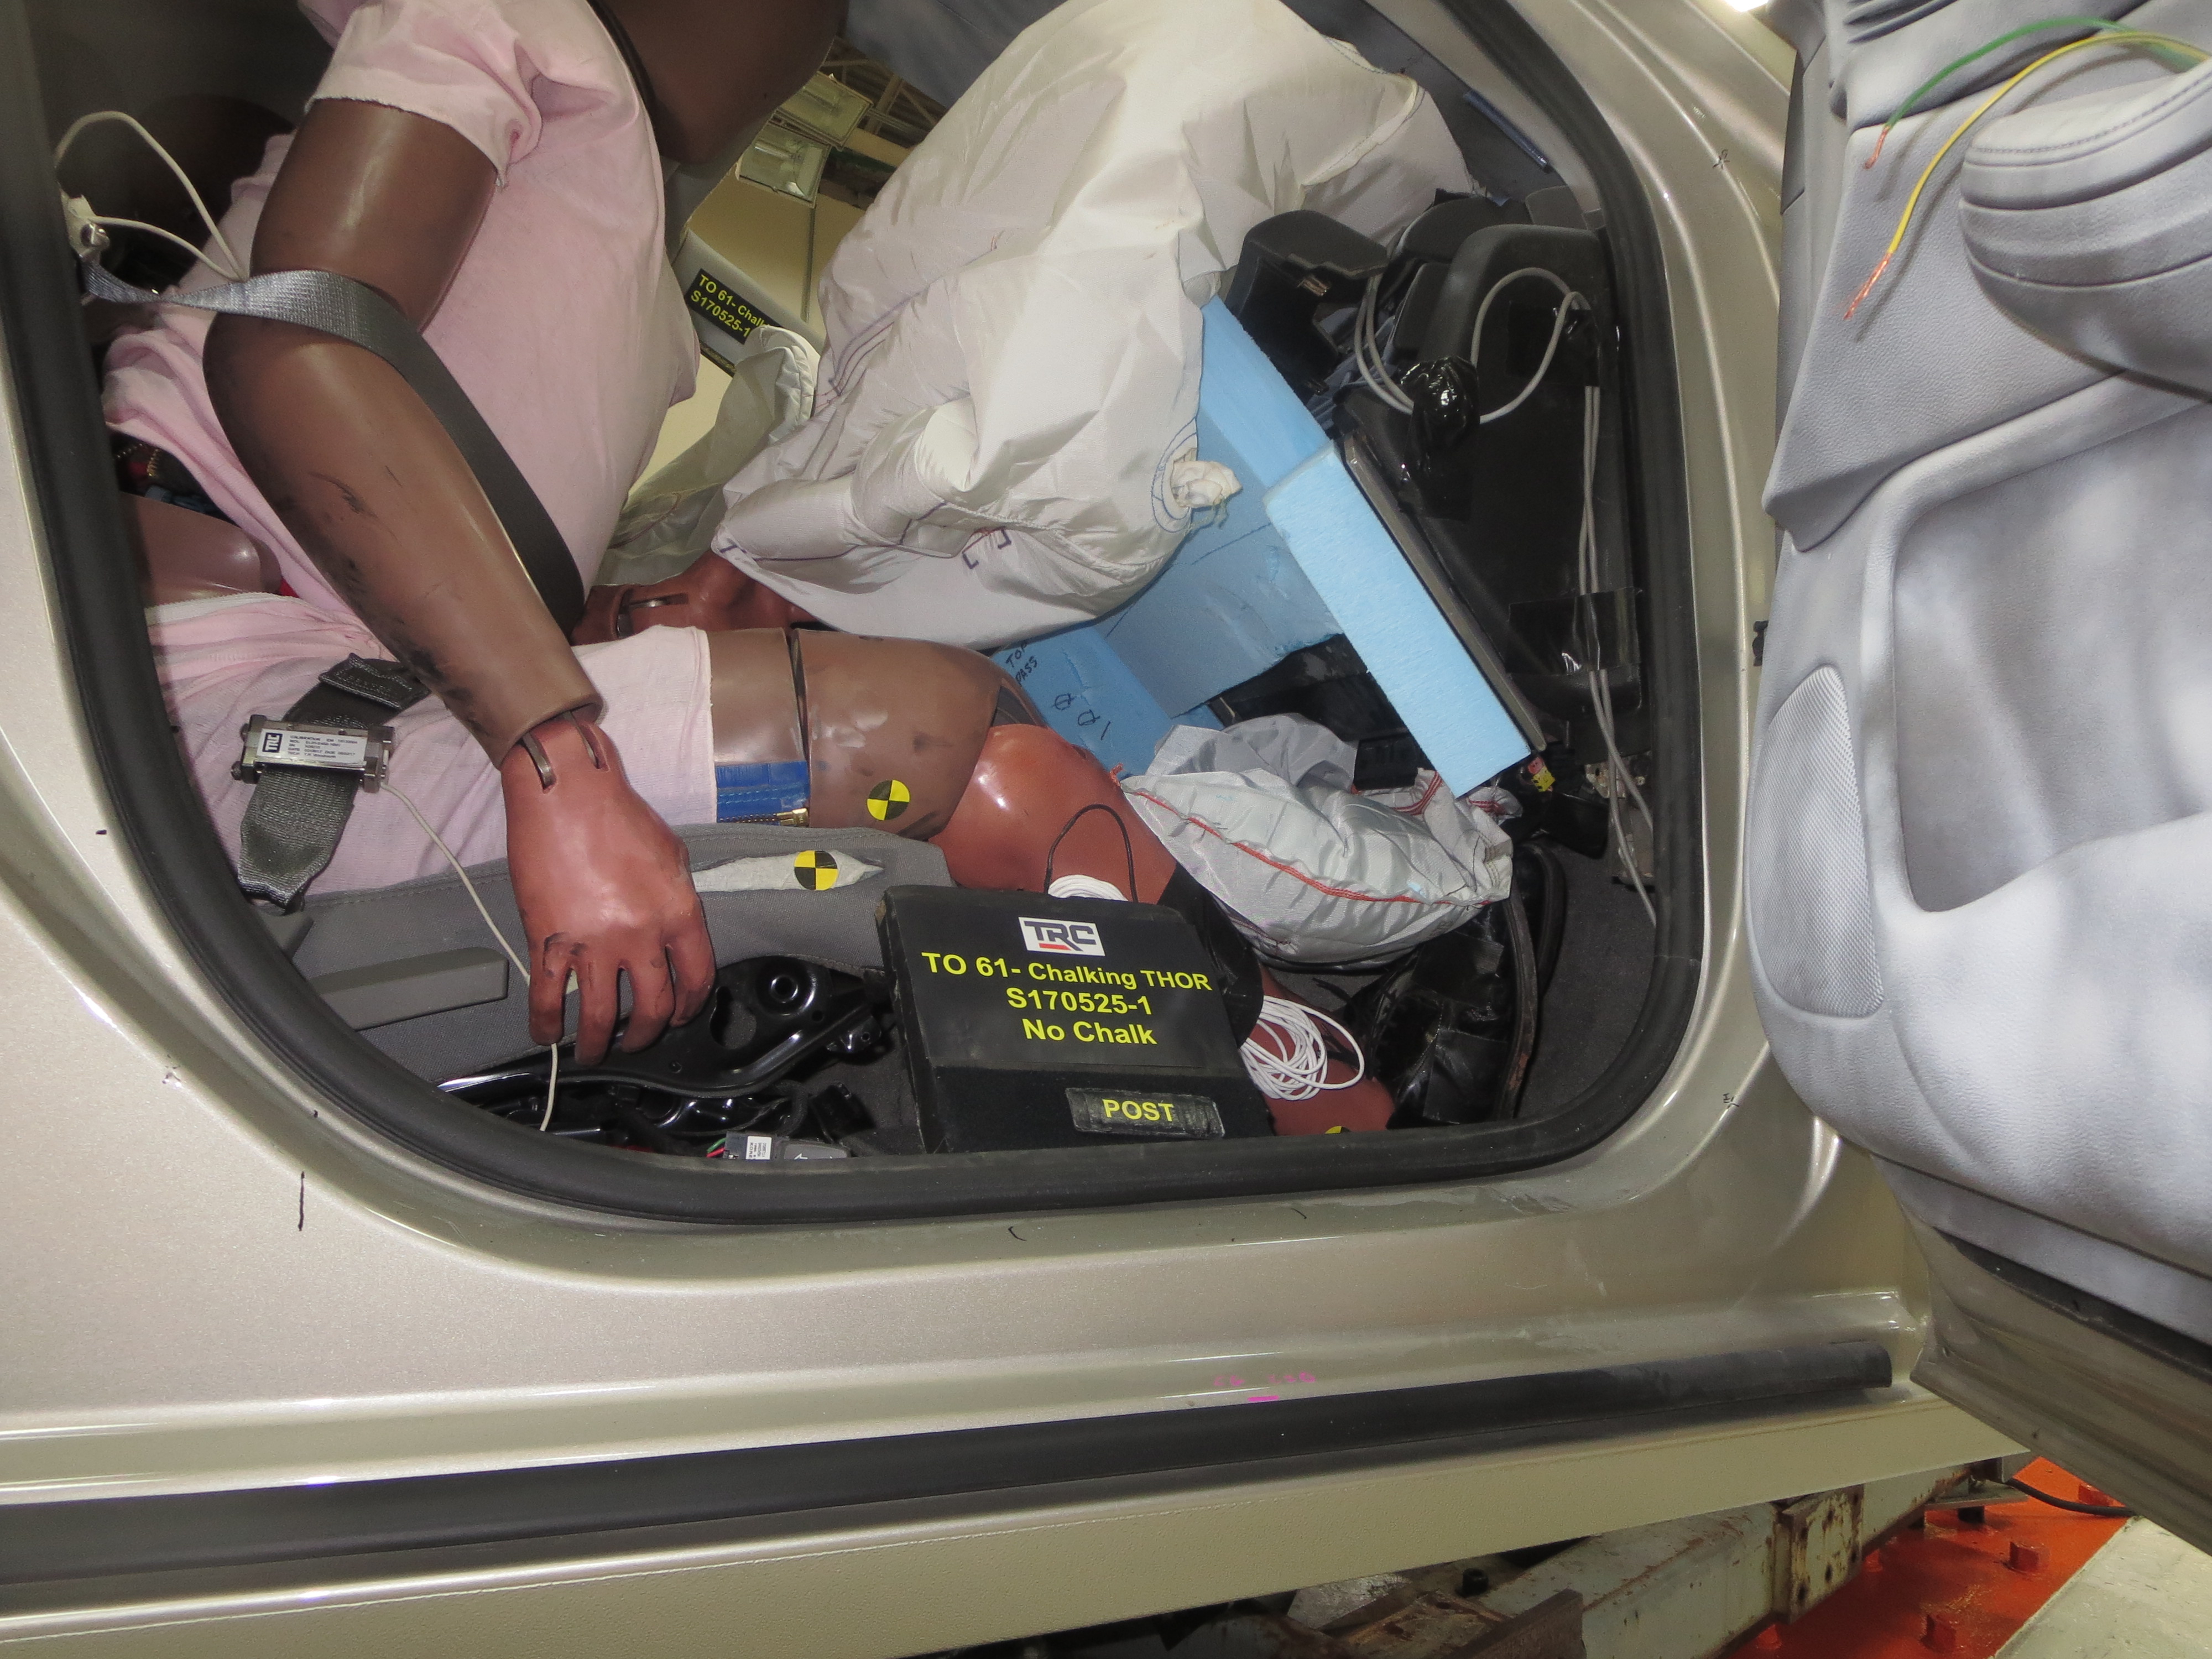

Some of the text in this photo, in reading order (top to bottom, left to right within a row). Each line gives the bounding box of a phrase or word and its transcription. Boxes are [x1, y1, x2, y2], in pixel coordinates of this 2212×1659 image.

[699, 274, 717, 294] TO
[718, 290, 736, 307] 61-
[691, 290, 751, 337] S170525-1
[1015, 656, 1037, 687] PASS
[1023, 920, 1097, 952] TRC
[921, 952, 1213, 991] TO 61- Chalking THOR
[1006, 987, 1152, 1015] S170525-1
[1022, 1019, 1158, 1045] No Chalk
[1102, 1099, 1174, 1122] POST
